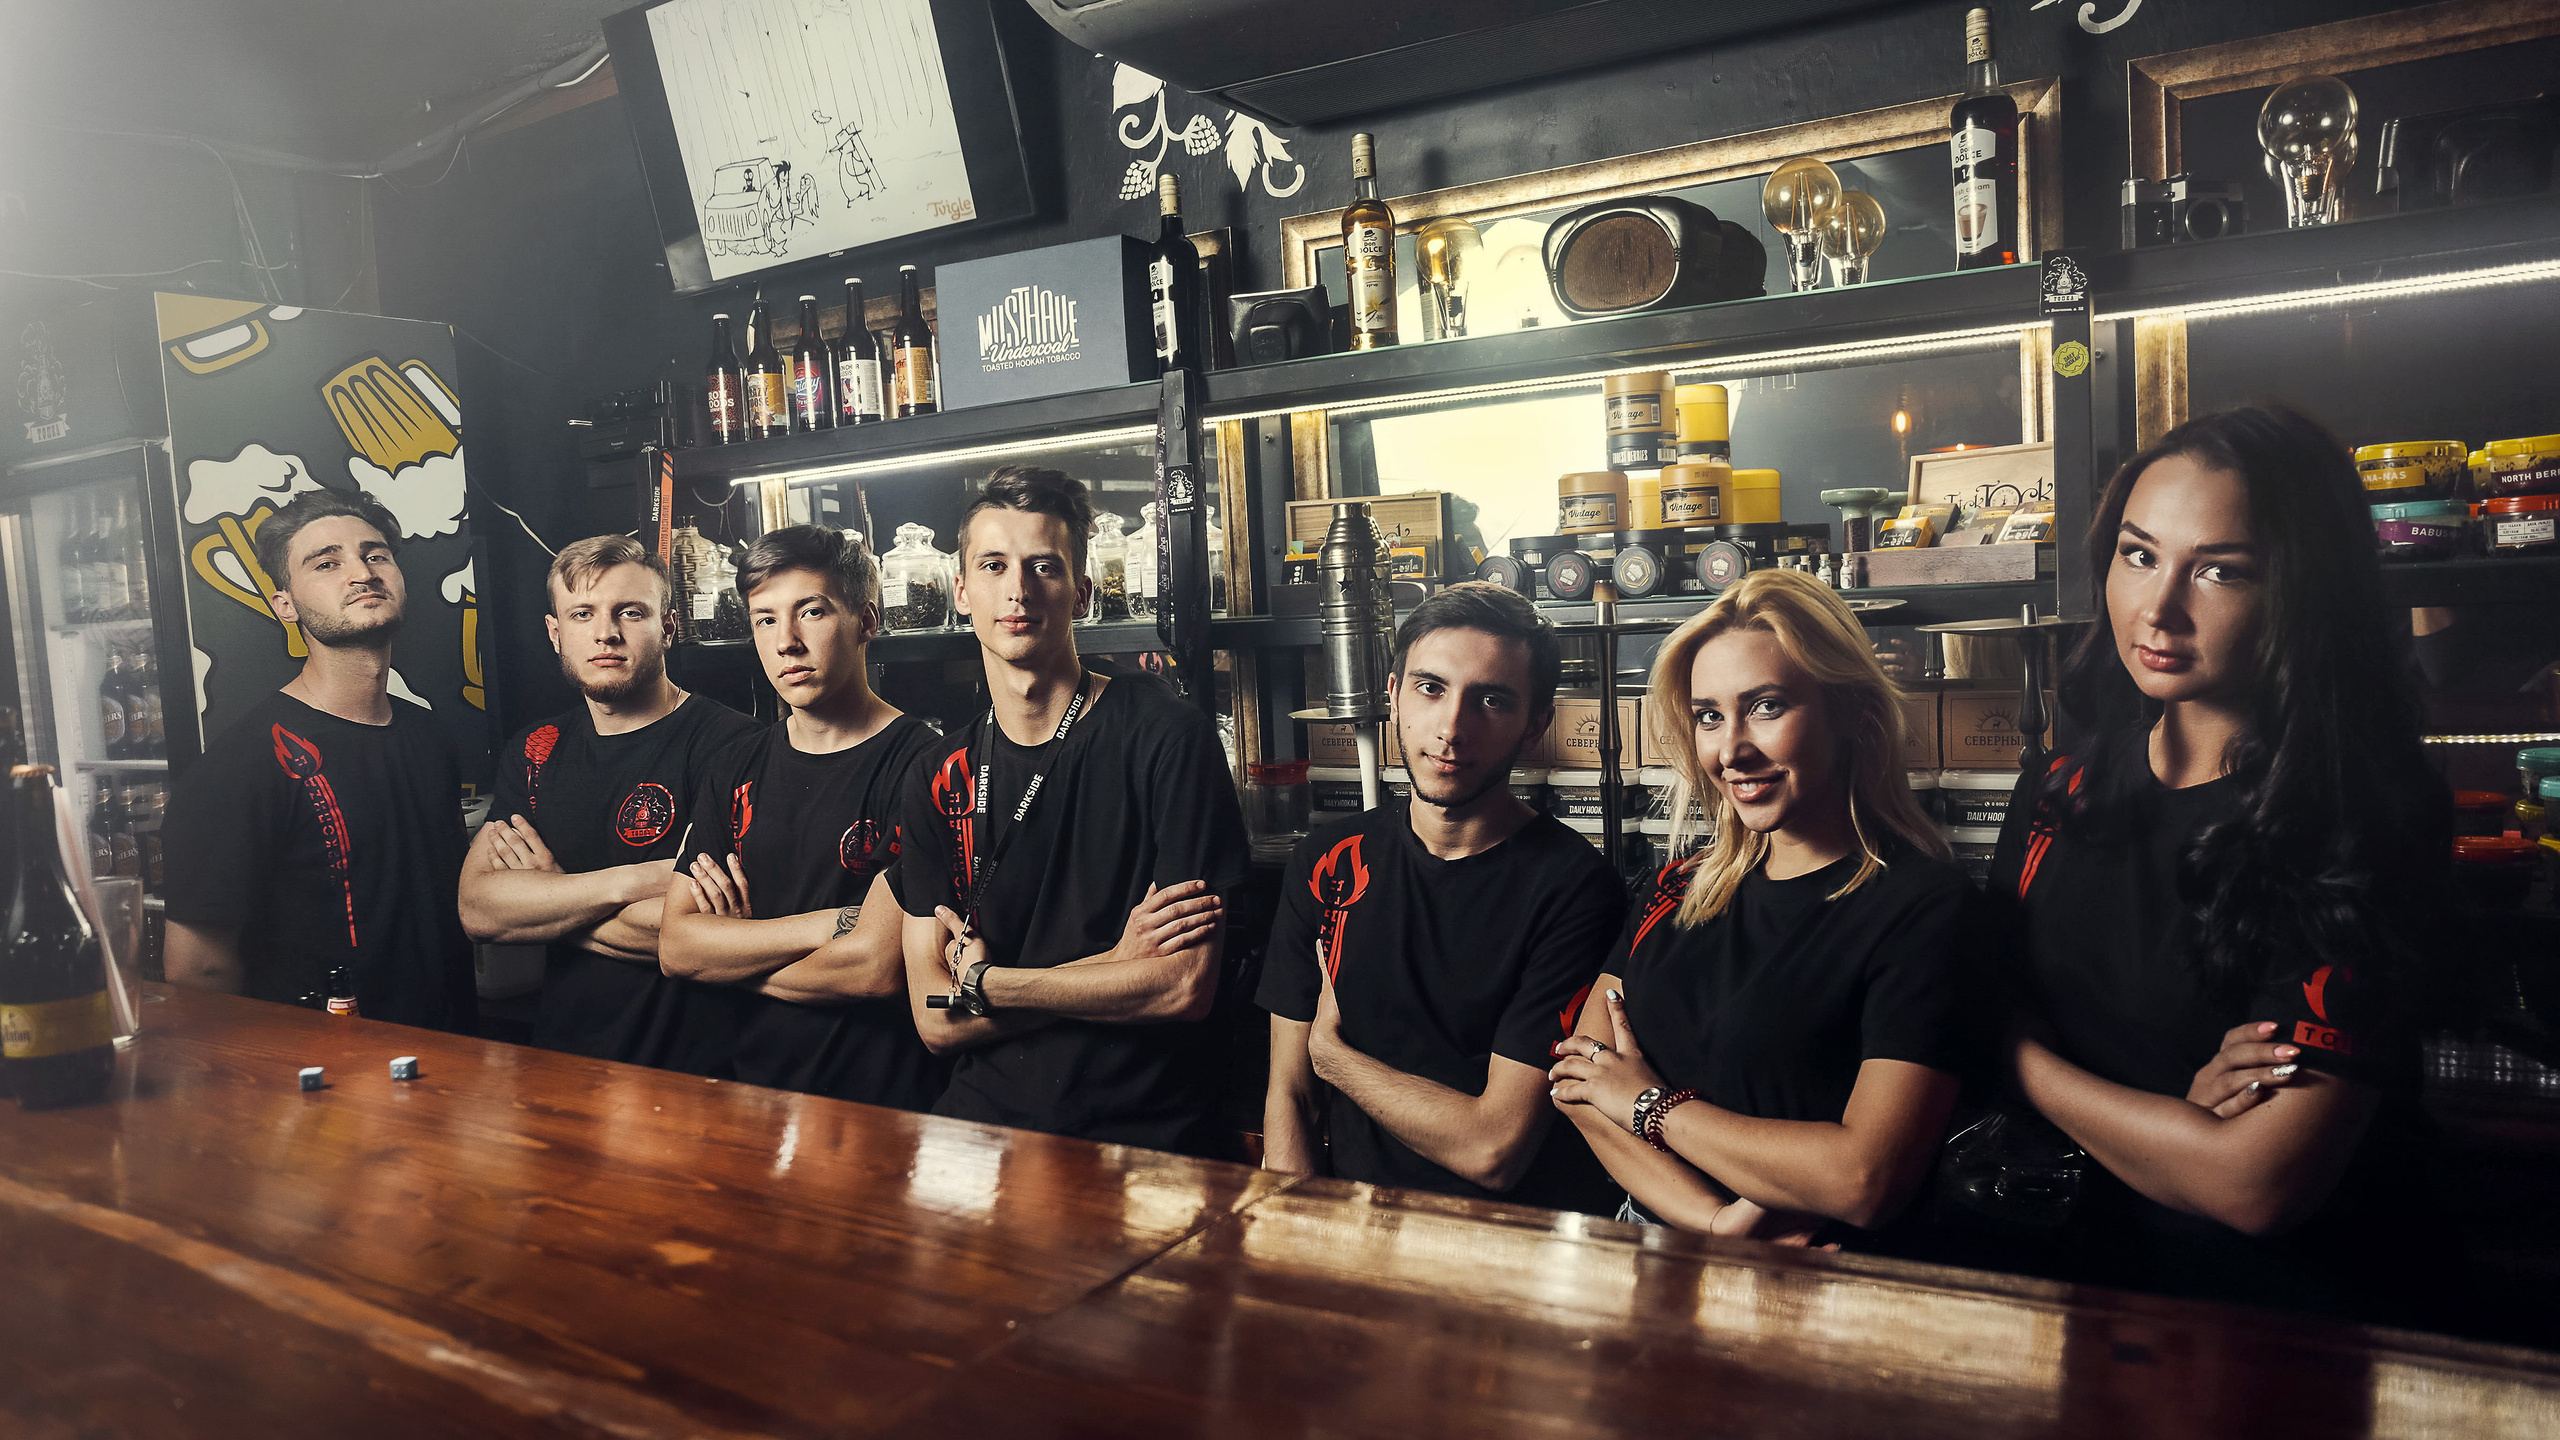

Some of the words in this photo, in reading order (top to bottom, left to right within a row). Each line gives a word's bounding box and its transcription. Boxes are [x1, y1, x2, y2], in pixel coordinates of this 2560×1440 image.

[928, 198, 973, 221] Tvigle
[977, 284, 1080, 358] MUSTHAVE
[989, 331, 1074, 363] Undercoal
[981, 361, 1014, 372] TOASTED
[1015, 357, 1045, 368] HOOKAH
[1047, 351, 1081, 364] TOBACCO
[2501, 473, 2532, 483] NORTH
[651, 486, 661, 522] DARKSIDE
[1568, 508, 1602, 519] Vintage
[1669, 502, 1703, 513] Vintage
[1056, 693, 1085, 740] DARKSIDE
[1964, 735, 2025, 746] СЕВЕРНЫ
[976, 765, 989, 814] DARKSIDE
[1013, 773, 1043, 822] DARKSIDE
[1569, 805, 1586, 814] DAILY
[1586, 805, 1603, 814] HOOK
[1966, 811, 1987, 821] DAILY
